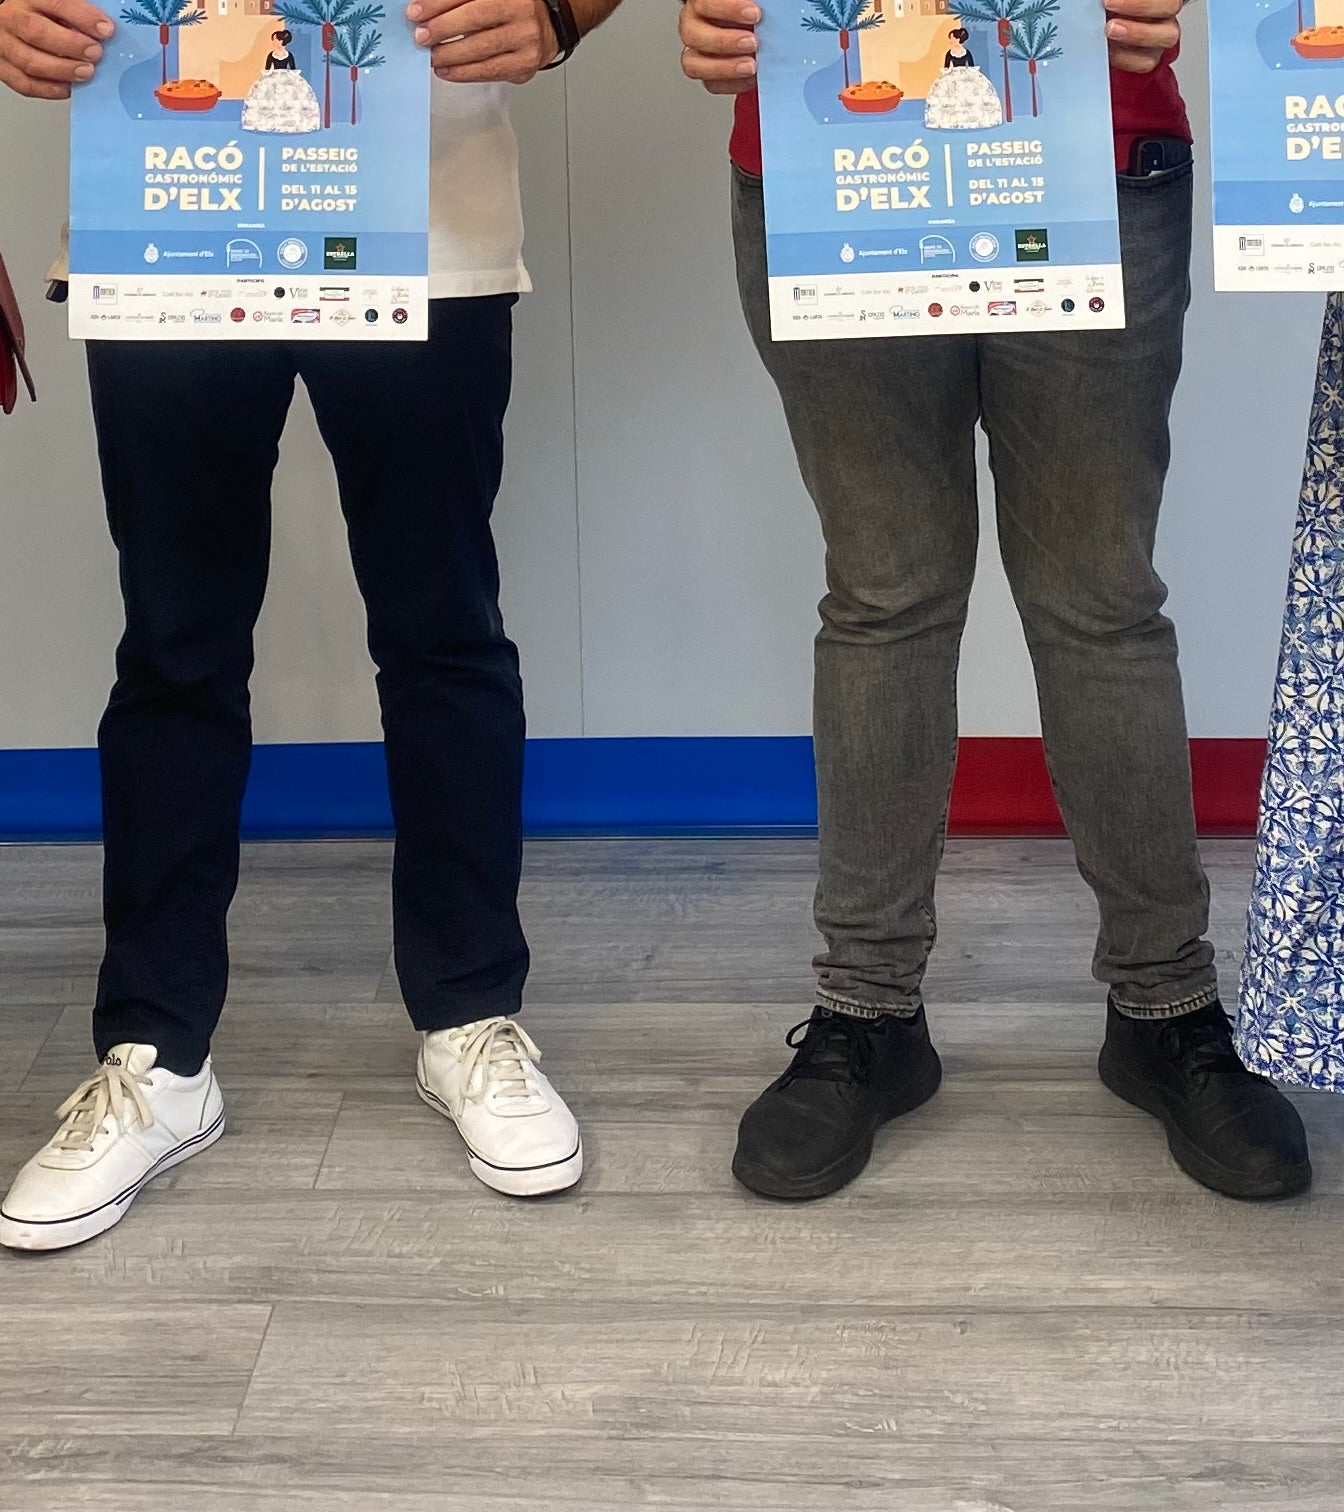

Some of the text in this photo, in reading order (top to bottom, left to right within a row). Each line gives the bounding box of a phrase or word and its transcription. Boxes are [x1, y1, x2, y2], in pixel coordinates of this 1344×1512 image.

[281, 147, 358, 161] PASSEIG
[966, 140, 1043, 156] PASSEIG
[144, 140, 243, 171] RACÓ
[833, 139, 930, 172] RACÓ
[967, 155, 1043, 168] DE L'ESTACIÓ
[282, 162, 358, 173] DE L'ESTACIÓ
[145, 173, 243, 184] GASTRONÓMIC
[835, 172, 930, 185] GASTRONÓMIC
[968, 177, 1045, 190] DEL 11 AL 15
[281, 184, 358, 195] DEL 11 AL 15
[144, 186, 242, 211] D'ELX
[281, 198, 357, 212] D'AGOST
[836, 185, 932, 212] D'ELX
[969, 190, 1045, 206] D'AGOST
[105, 1053, 122, 1066] olo
